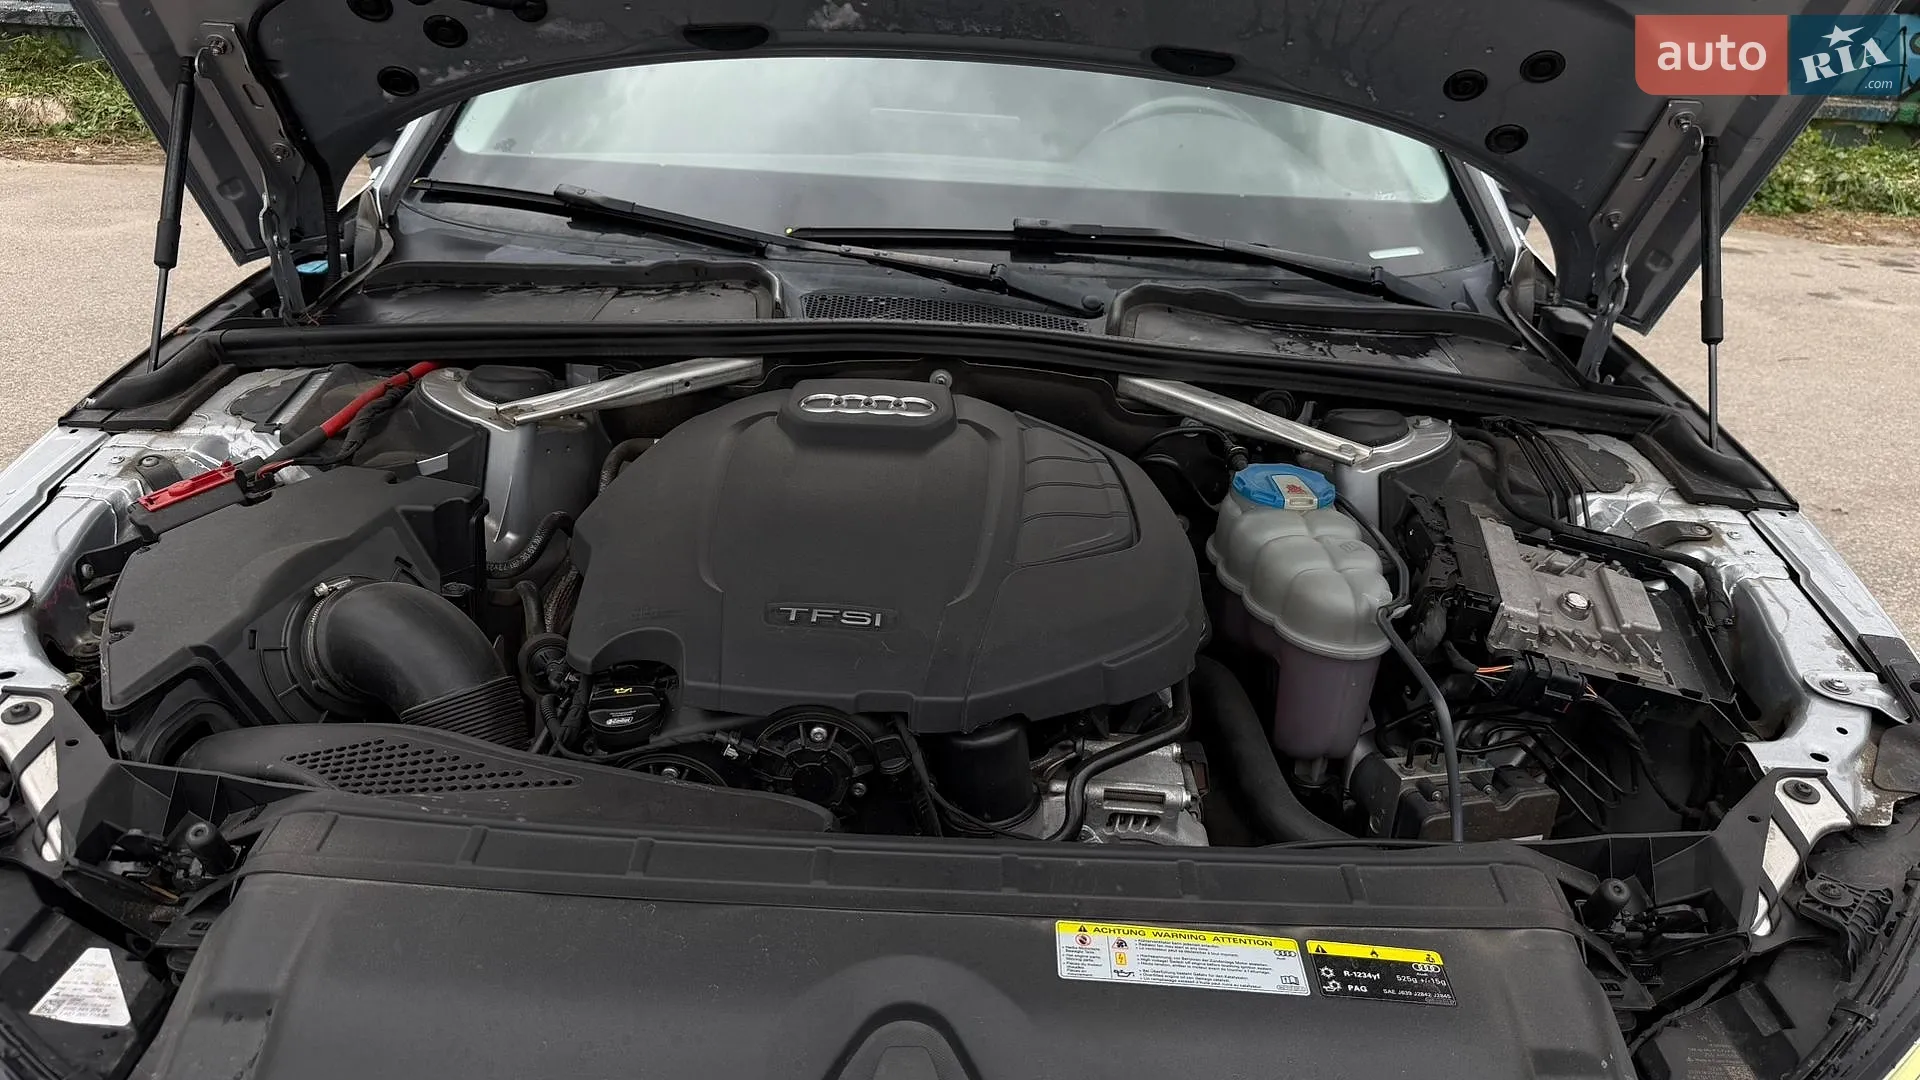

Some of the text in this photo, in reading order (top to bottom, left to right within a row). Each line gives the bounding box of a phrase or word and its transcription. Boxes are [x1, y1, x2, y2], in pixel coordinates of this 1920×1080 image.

[780, 607, 881, 627] TFSI
[1093, 927, 1273, 947] ACHTUNG WARNING ATTENTION
[1343, 970, 1380, 980] R-1234yf
[1397, 975, 1418, 984] 525g
[1347, 984, 1368, 992] PAG
